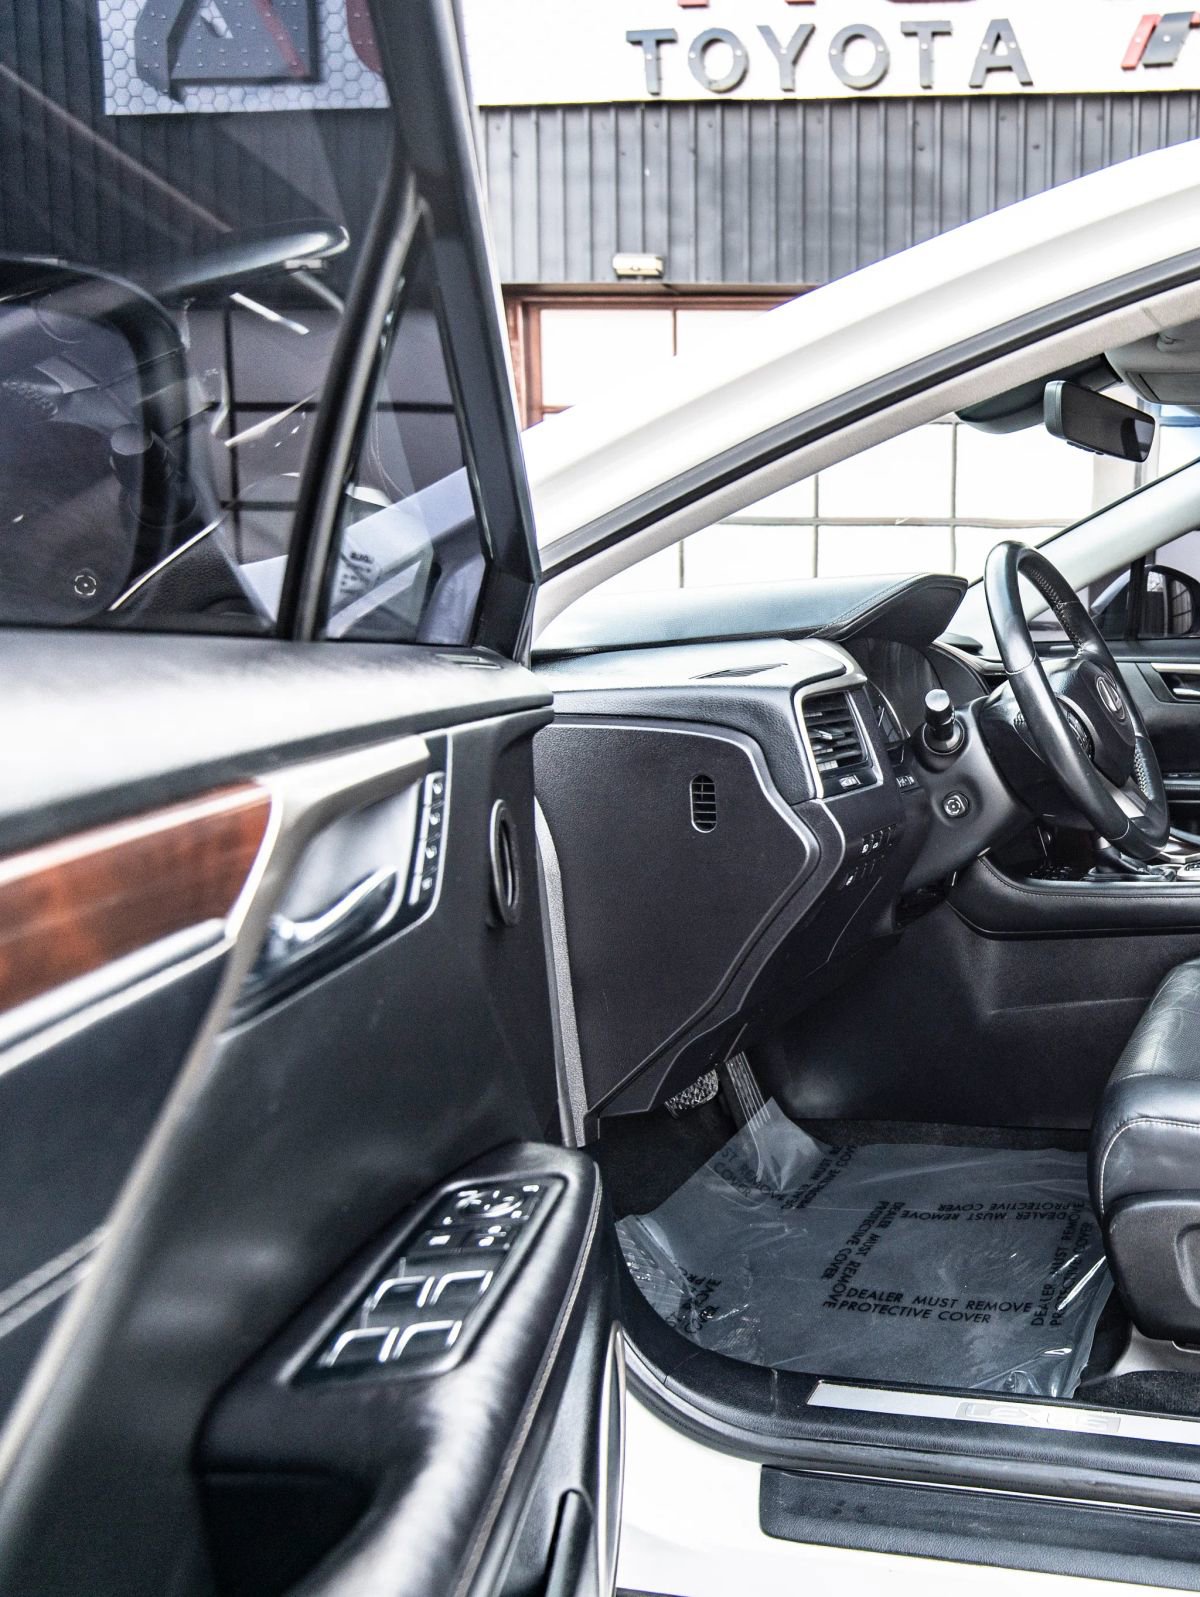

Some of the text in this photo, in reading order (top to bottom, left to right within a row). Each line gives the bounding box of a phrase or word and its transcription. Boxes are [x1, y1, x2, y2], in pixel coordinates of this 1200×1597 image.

[626, 18, 1034, 96] TOYOTA
[900, 1209, 1068, 1222] DEALER MUST REMOVE
[937, 1201, 1072, 1212] PROTECTIVE COVER
[820, 1200, 890, 1281] PROTECTIVE COVER
[822, 1200, 906, 1309] DEALER MUST REMOVE
[837, 1300, 992, 1324] PROTECTIVE COVER
[845, 1286, 1034, 1313] DEALER MUST REMOVE
[1030, 1283, 1056, 1327] DEALER
